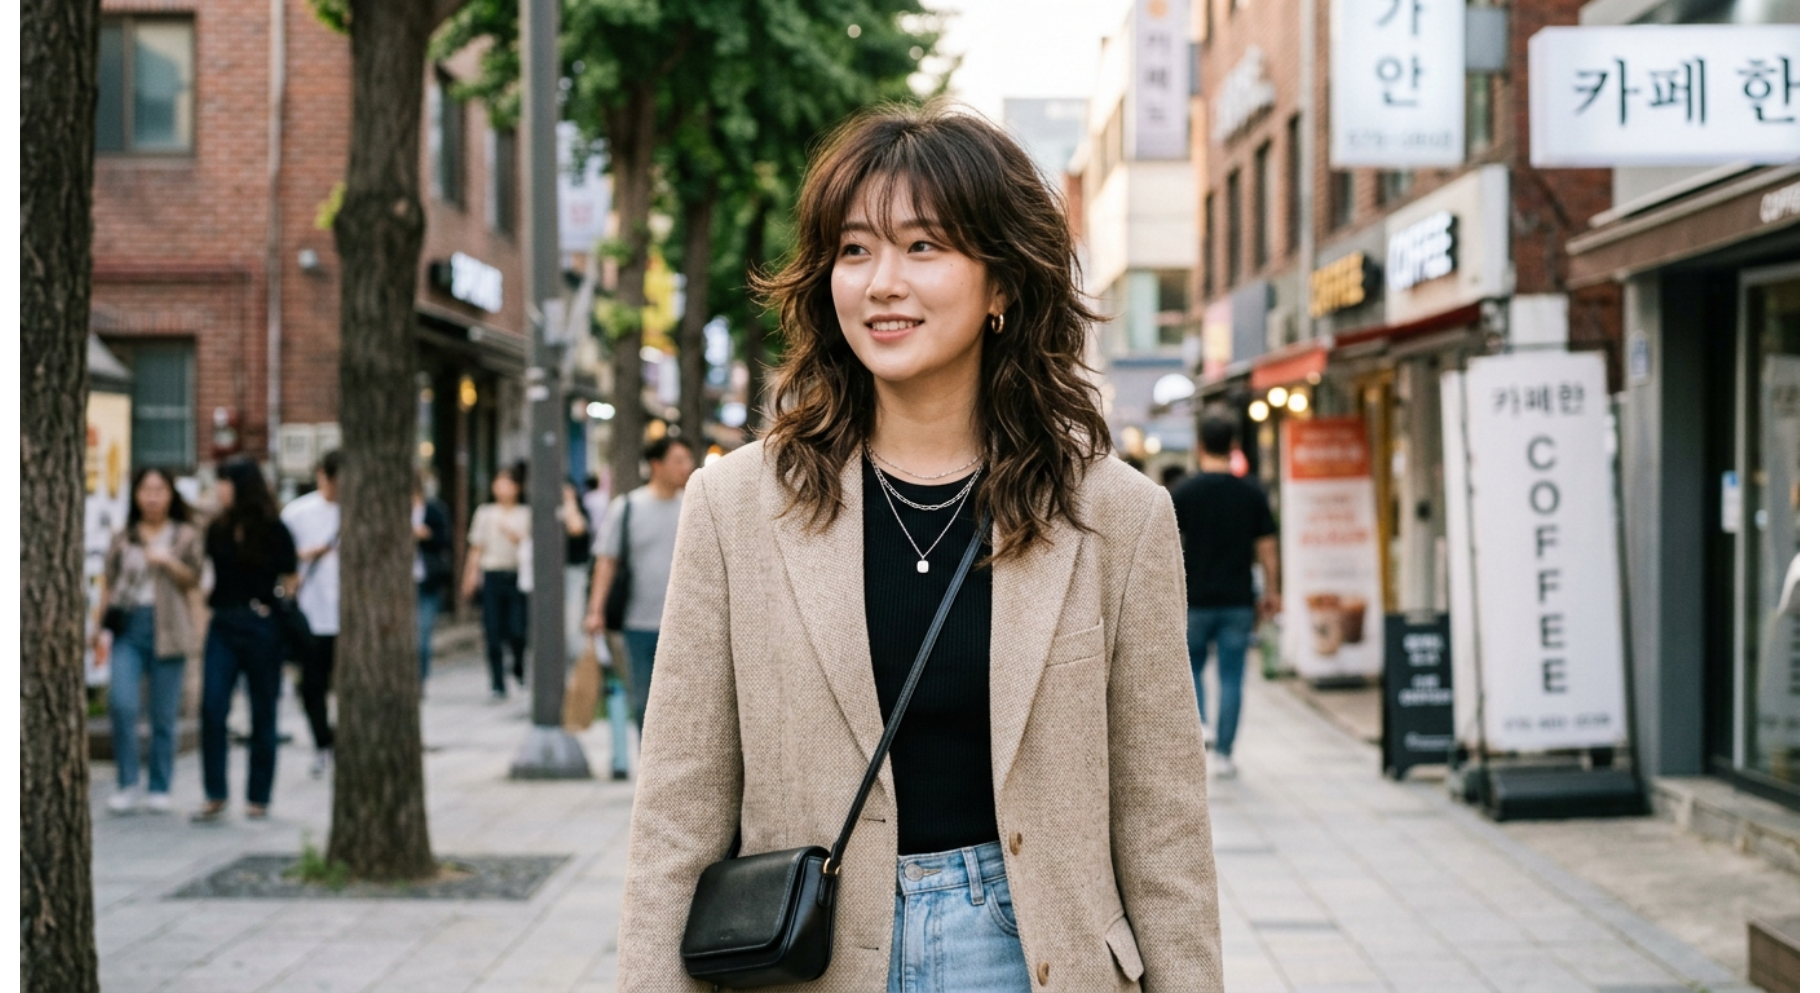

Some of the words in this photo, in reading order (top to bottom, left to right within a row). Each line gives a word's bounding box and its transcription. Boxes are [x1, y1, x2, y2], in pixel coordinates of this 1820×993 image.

[1574, 56, 1706, 126] 카페
[1736, 56, 1800, 123] 한
[1494, 382, 1586, 415] 카페한
[1527, 435, 1567, 693] COFFEE
